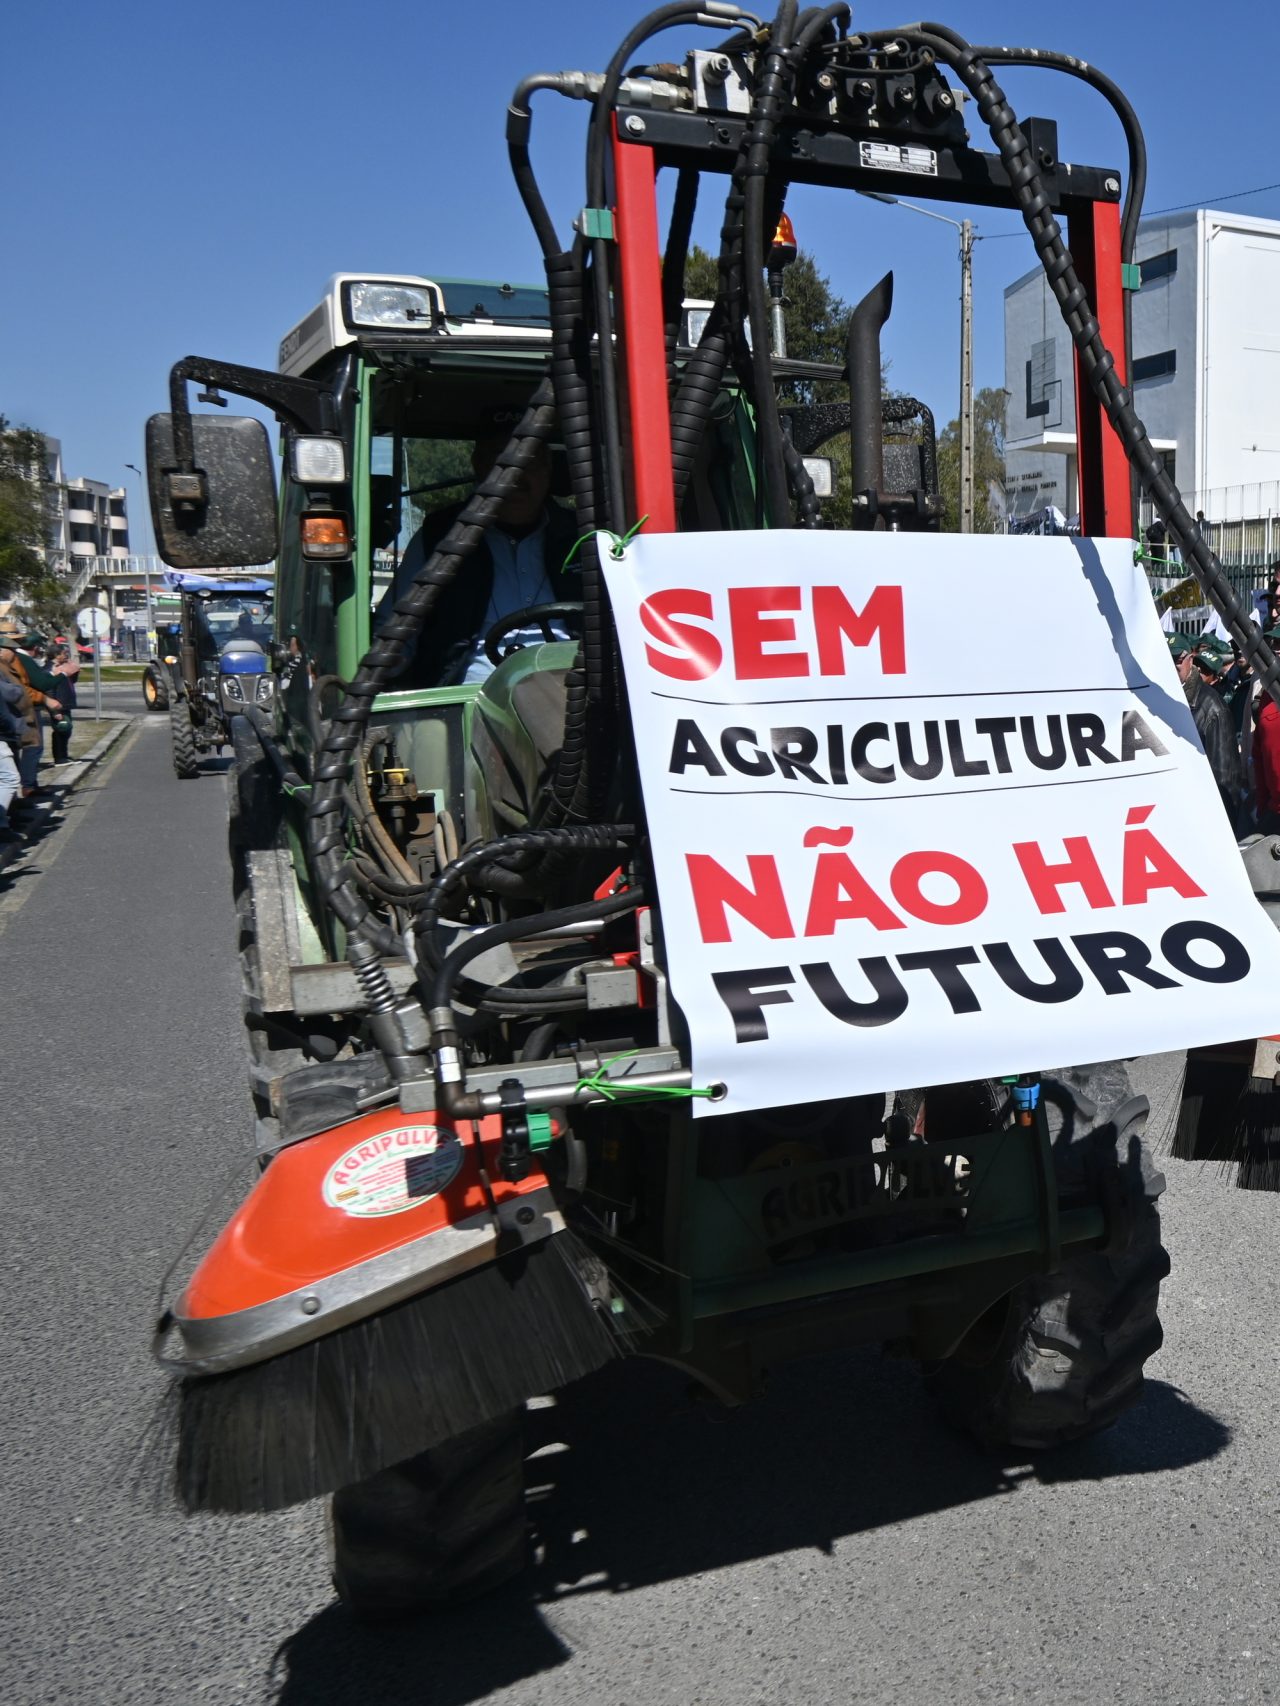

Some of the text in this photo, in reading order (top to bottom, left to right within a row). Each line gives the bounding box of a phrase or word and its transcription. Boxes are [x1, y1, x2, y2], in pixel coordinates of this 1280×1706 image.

[638, 585, 907, 682] SEM
[1201, 651, 1214, 659] CAP
[668, 712, 1169, 785] AGRICULTURA
[684, 804, 1208, 944] NÃO HÁ
[711, 920, 1251, 1044] FUTURO
